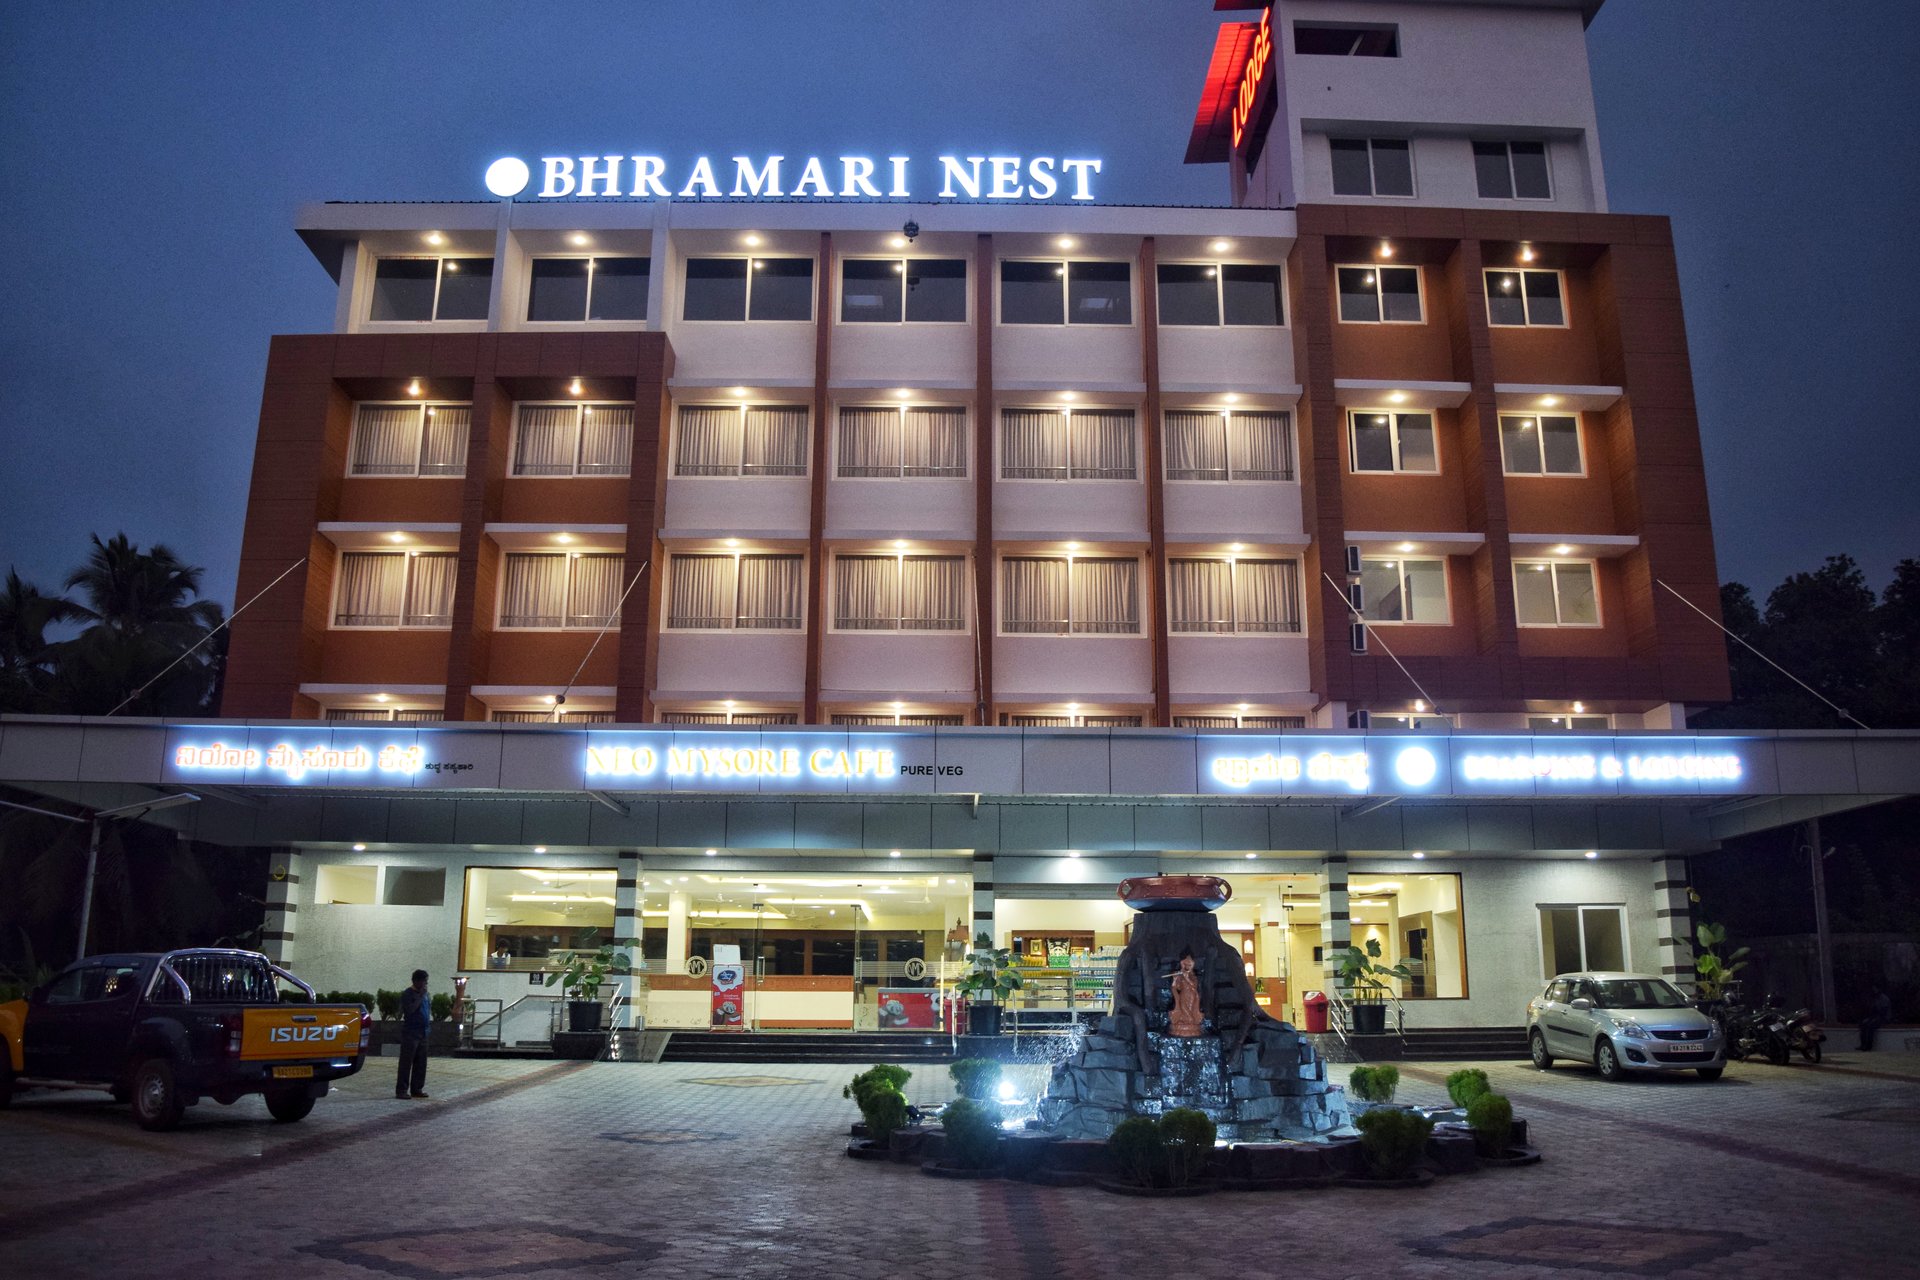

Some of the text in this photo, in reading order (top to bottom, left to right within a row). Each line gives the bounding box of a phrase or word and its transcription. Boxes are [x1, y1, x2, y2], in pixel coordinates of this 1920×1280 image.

[1232, 6, 1271, 149] LODGE
[537, 155, 1103, 201] BHRAMARI NEST
[585, 746, 895, 778] NEO MYSORE CAFE
[900, 764, 964, 777] PURE VEG
[1628, 755, 1743, 779] LODGING
[269, 1026, 339, 1042] ISUZU
